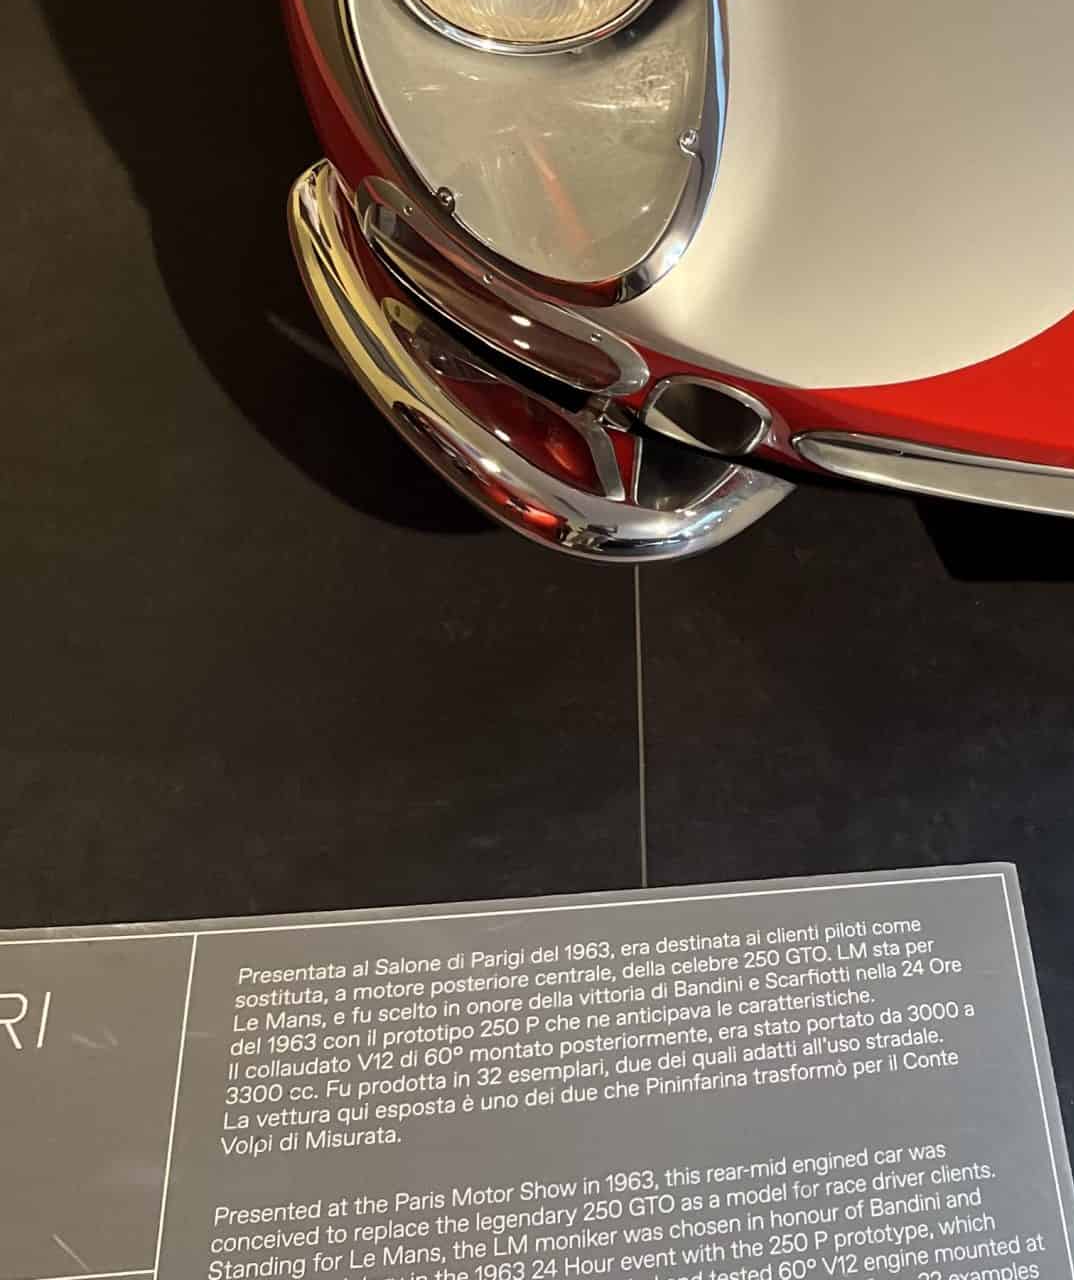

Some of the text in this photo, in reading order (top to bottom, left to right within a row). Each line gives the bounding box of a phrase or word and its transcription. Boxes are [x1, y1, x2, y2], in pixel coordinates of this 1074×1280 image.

[235, 940, 934, 1008] sostituta, a motore posteriore centrale, della celebre 250 GTO. LM sta per
[238, 920, 921, 984] Presentata al Salone di Parigi del 1963, era destinata ai clienti piloti come
[230, 989, 875, 1056] del 1963 con il prototipo 250 P che ne anticipava le caratteristiche.
[233, 958, 962, 1032] Le Mans, e fu scelto in onore della vittoria di Bandini e Scarfiotti nella 24 Ore
[225, 1027, 944, 1105] 3300 cc. Fu prodotta in 32 esemplari, due dei quali adatti all'uso stradale.
[229, 1062, 239, 1080] Il
[245, 1056, 351, 1079] collaudato
[357, 1051, 394, 1071] V12
[400, 1050, 418, 1068] di
[469, 1040, 553, 1062] montato
[560, 1027, 712, 1059] posteriormente,
[718, 1025, 748, 1040] era
[753, 1018, 801, 1037] stato
[807, 1011, 874, 1035] portato
[880, 1008, 902, 1024] da
[907, 1001, 959, 1022] 3000
[964, 1004, 975, 1016] a
[224, 1050, 959, 1130] La vettura qui esposta è uno dei due che Pininfarina trasformò per il Conte
[221, 1127, 401, 1158] Volpi di Misurata.
[211, 1162, 996, 1253] conceived to replace the legendary 250 GTO as a model for race driver clients.
[214, 1144, 946, 1227] Presented at the Paris Motor Show in 1963, this rear-mid engined car was
[208, 1187, 981, 1280] Standing for Le Mans, the LM moniker was chosen in honour of Bandini and
[769, 1212, 995, 1255] 250 P prototype, which
